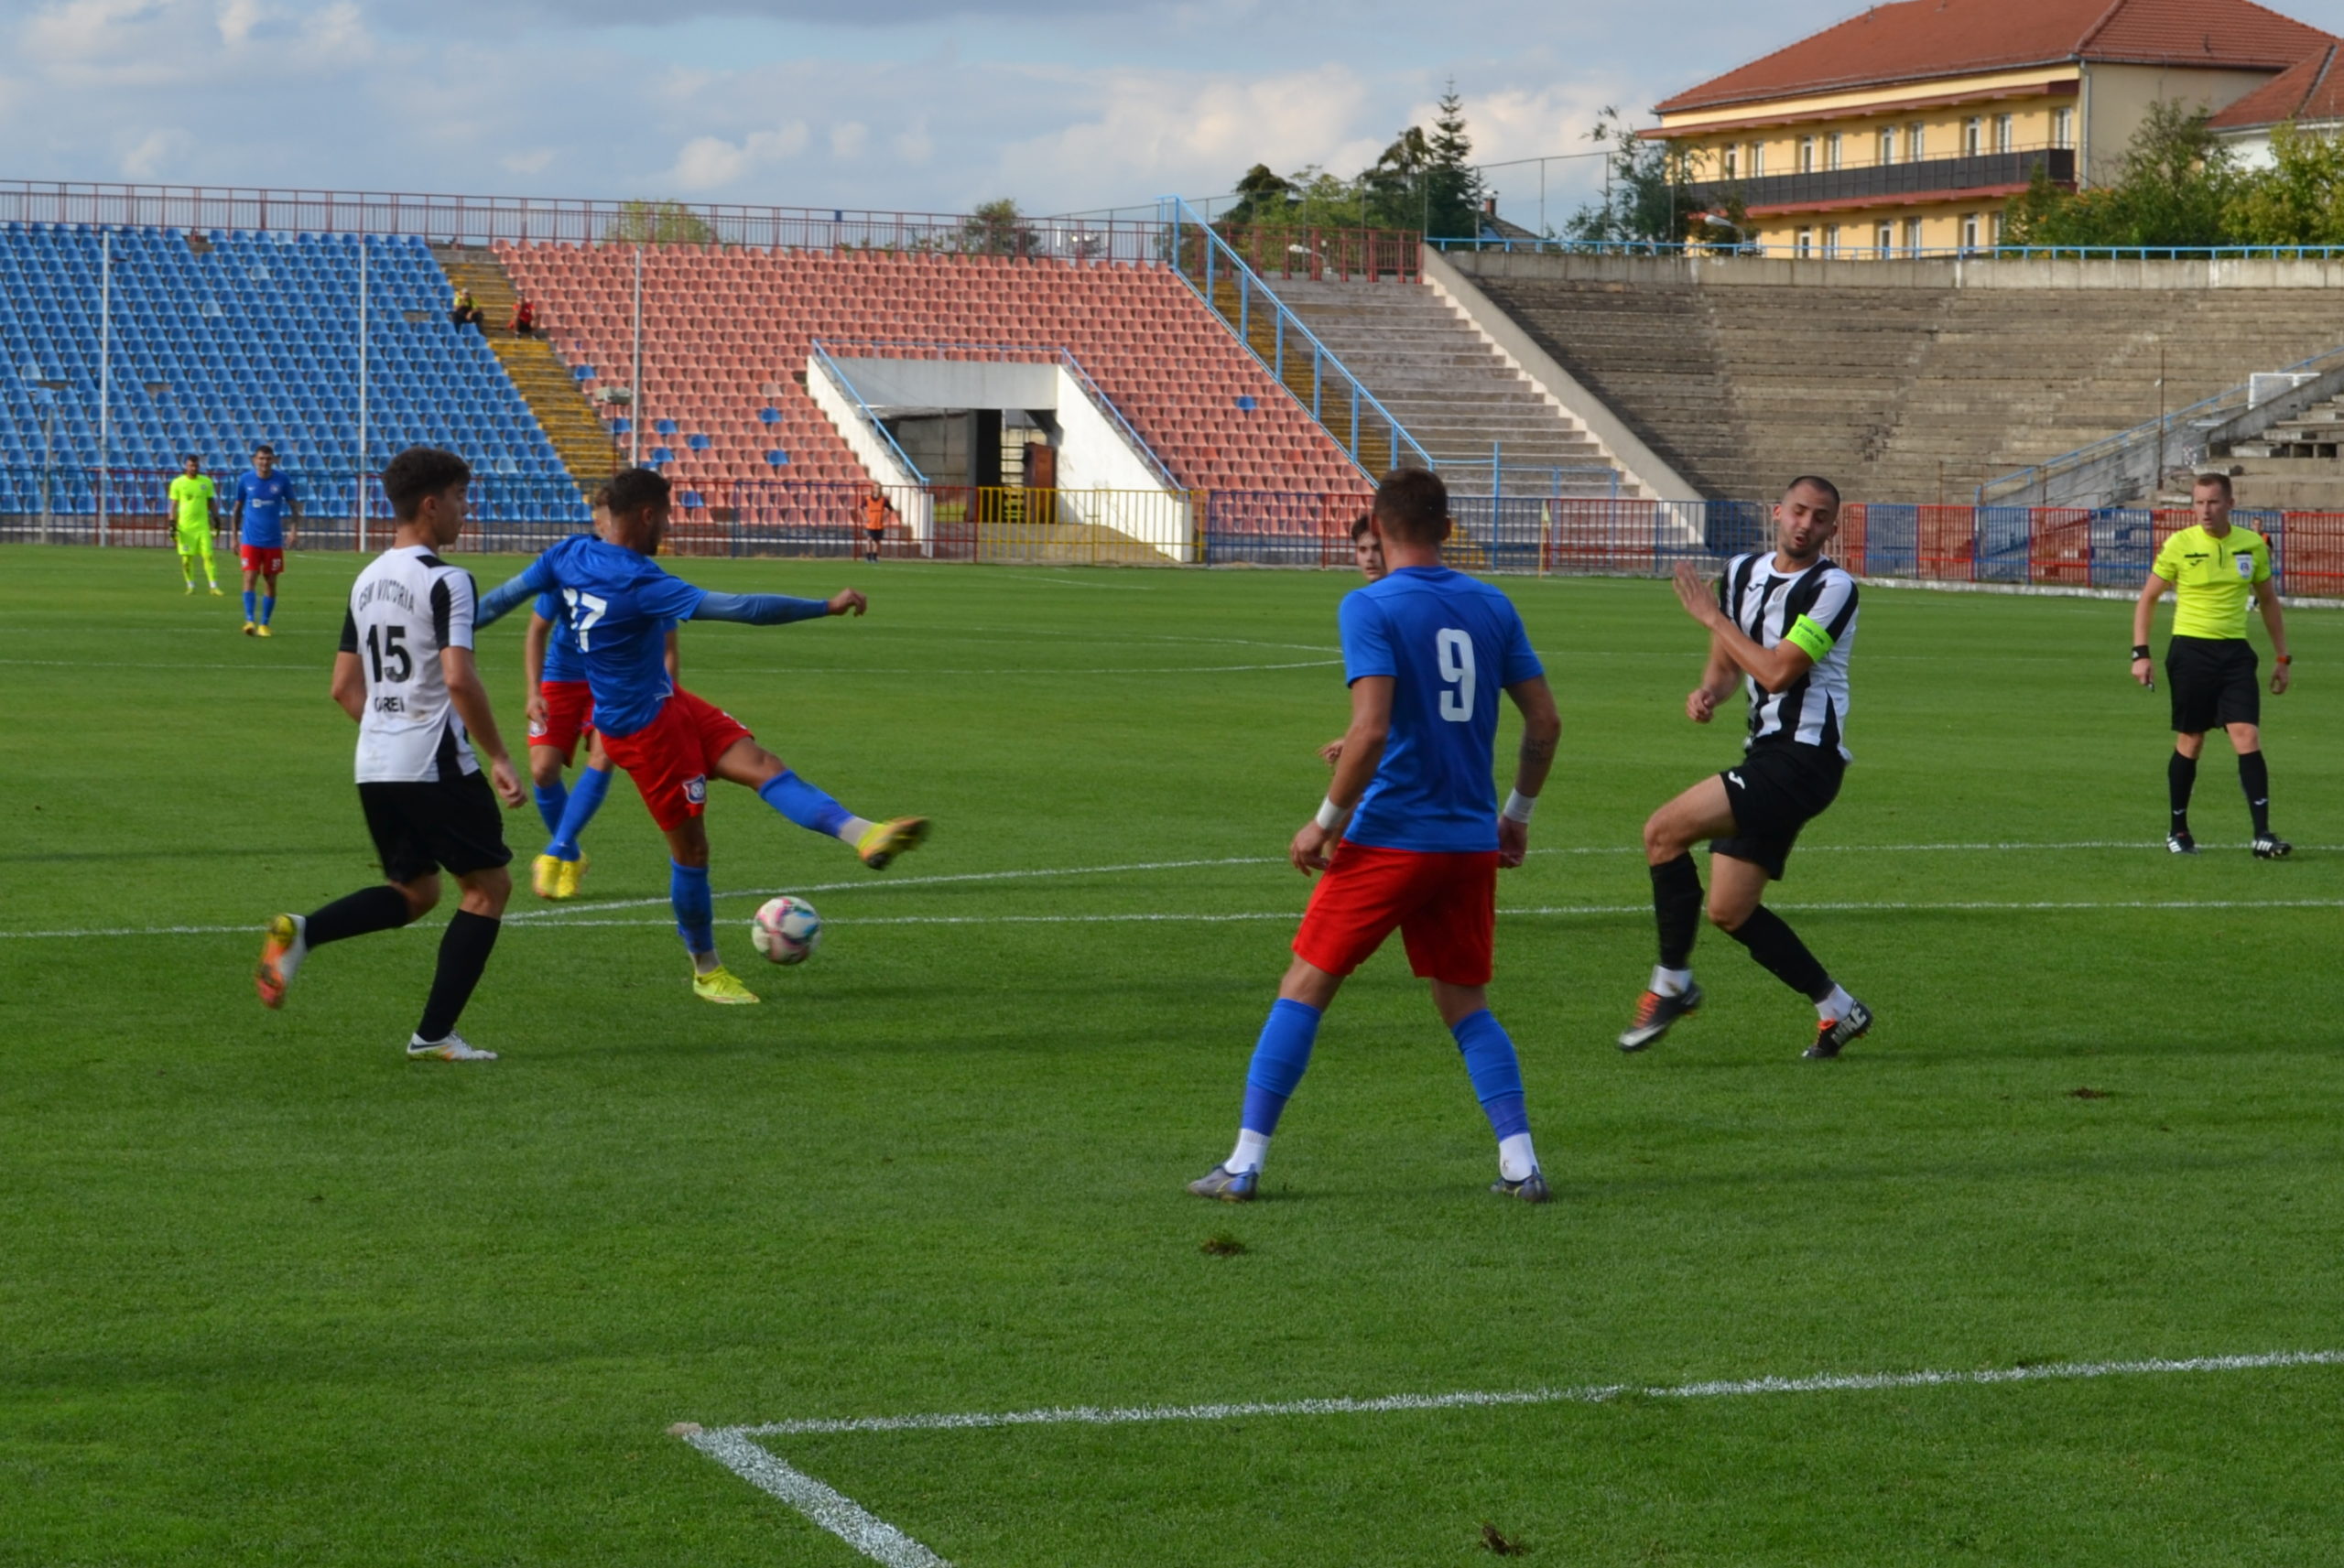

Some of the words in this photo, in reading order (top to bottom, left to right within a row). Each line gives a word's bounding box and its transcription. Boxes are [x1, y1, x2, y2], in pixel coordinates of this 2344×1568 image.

[377, 579, 414, 614] VICTORIA
[366, 623, 411, 683] 15
[1436, 627, 1476, 721] 9
[1831, 1007, 1867, 1045] NIKE
